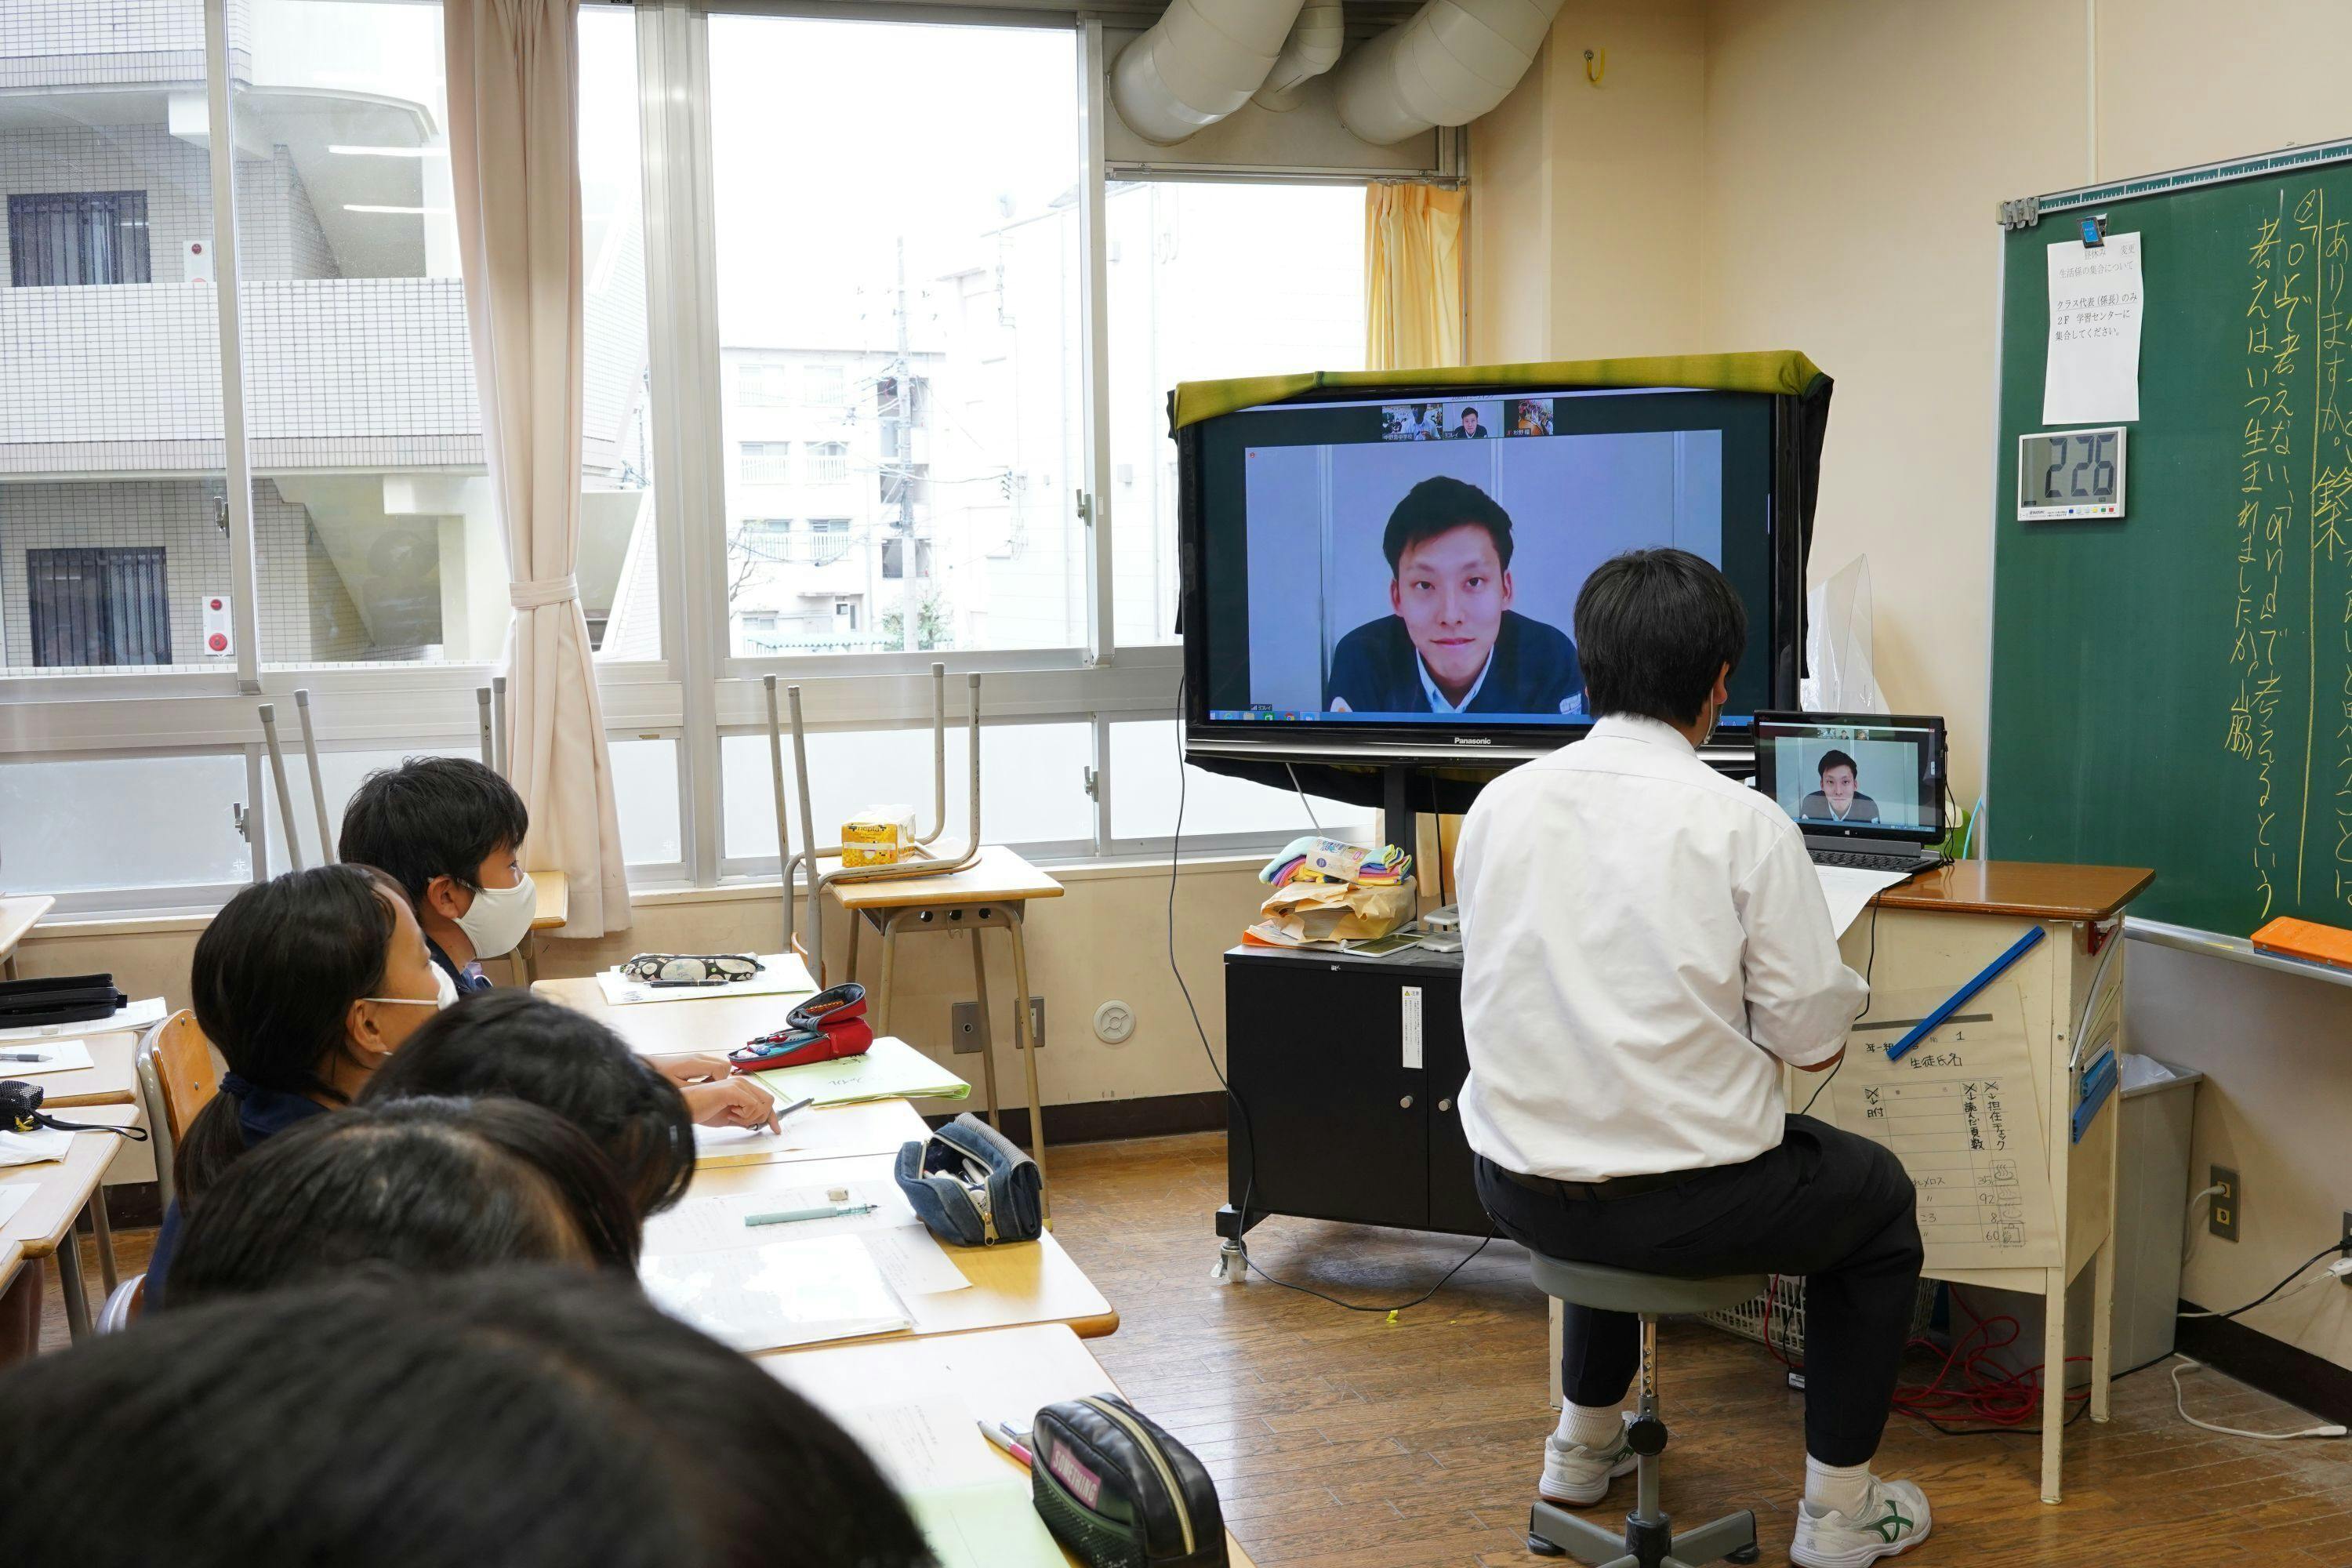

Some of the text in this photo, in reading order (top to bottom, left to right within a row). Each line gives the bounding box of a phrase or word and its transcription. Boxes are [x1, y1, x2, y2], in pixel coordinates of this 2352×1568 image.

[2059, 260, 2134, 279] 生活係の集合について
[2055, 326, 2120, 342] 集合してください。
[1910, 1052, 1962, 1069] 生徒氏名
[1867, 1107, 1884, 1118] 日付
[1053, 1450, 1098, 1502] SOMETHING
